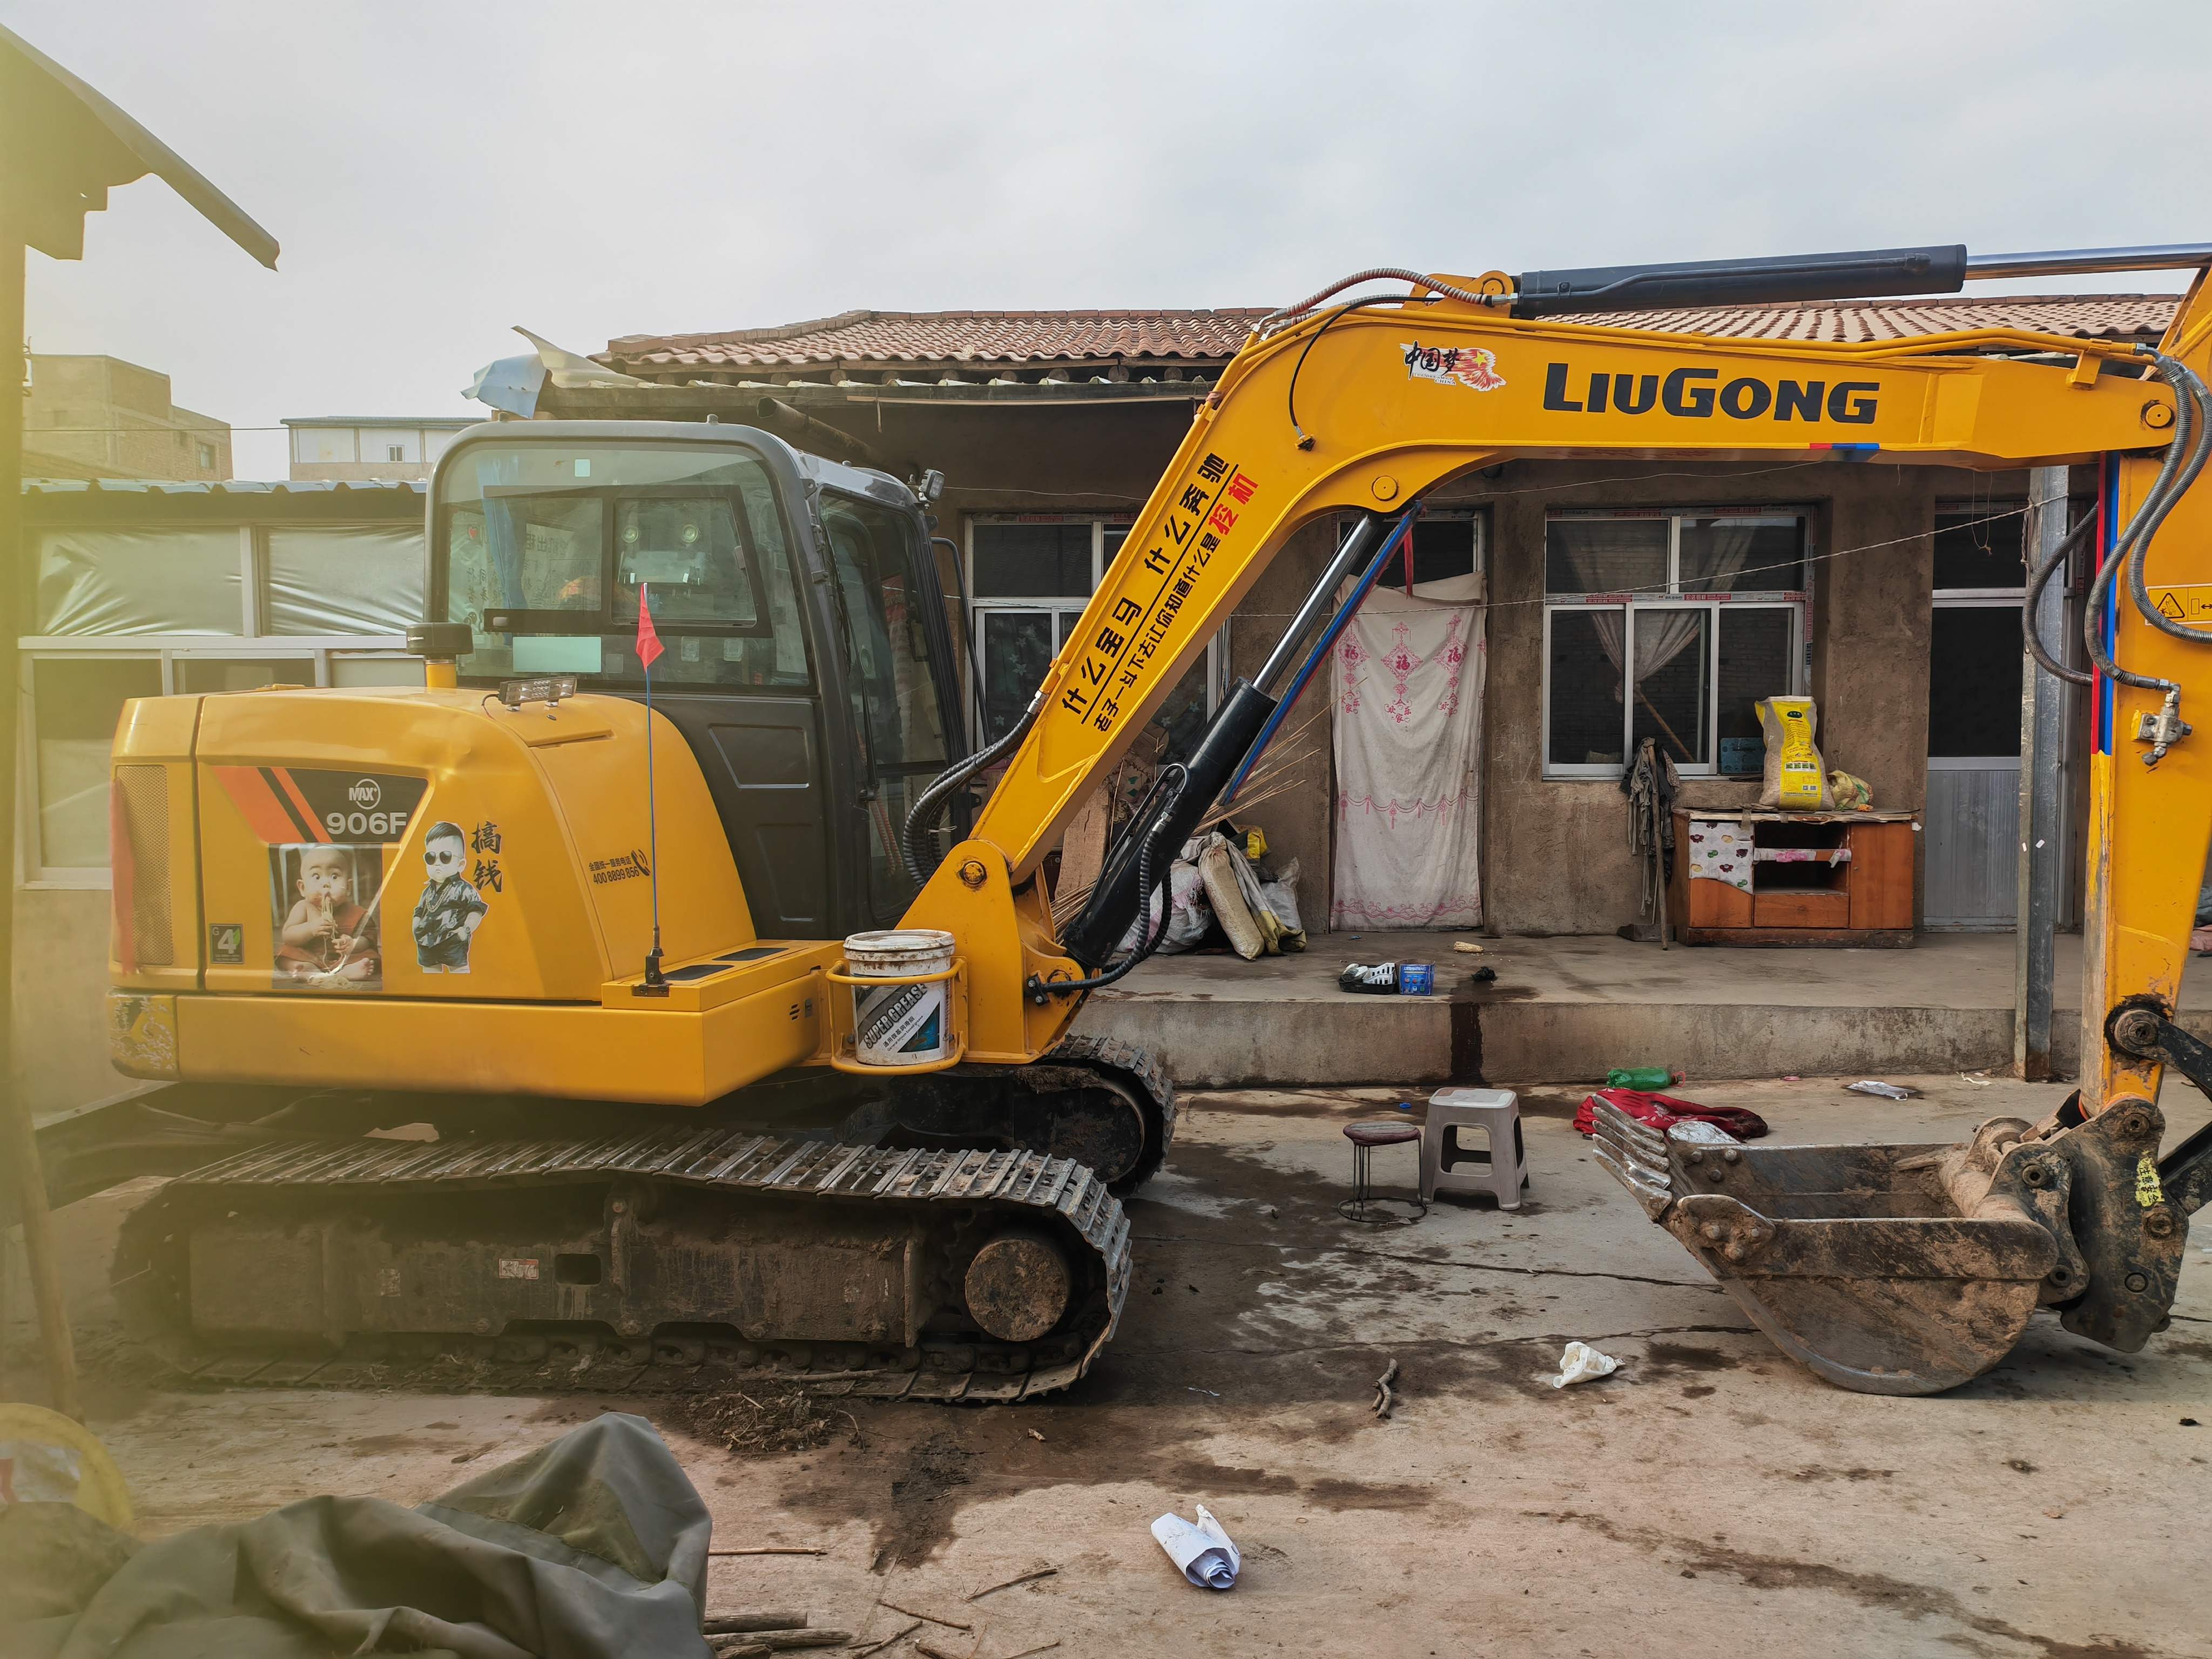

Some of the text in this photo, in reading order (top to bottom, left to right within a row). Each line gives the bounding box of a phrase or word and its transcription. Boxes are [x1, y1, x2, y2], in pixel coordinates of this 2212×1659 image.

[1405, 341, 1461, 379] 中国梦
[1543, 363, 1880, 424] LIUGONG
[1062, 453, 1230, 715] 什么宝马 什么奔驰
[1345, 644, 1359, 660] 福
[1396, 654, 1410, 670] 福
[1448, 646, 1461, 663] 福
[326, 812, 407, 835] 906F
[471, 821, 503, 893] 搞钱
[589, 856, 632, 871] 全国统一服务电话
[593, 866, 640, 884] 400 8899 856
[864, 1015, 895, 1049] SUPER
